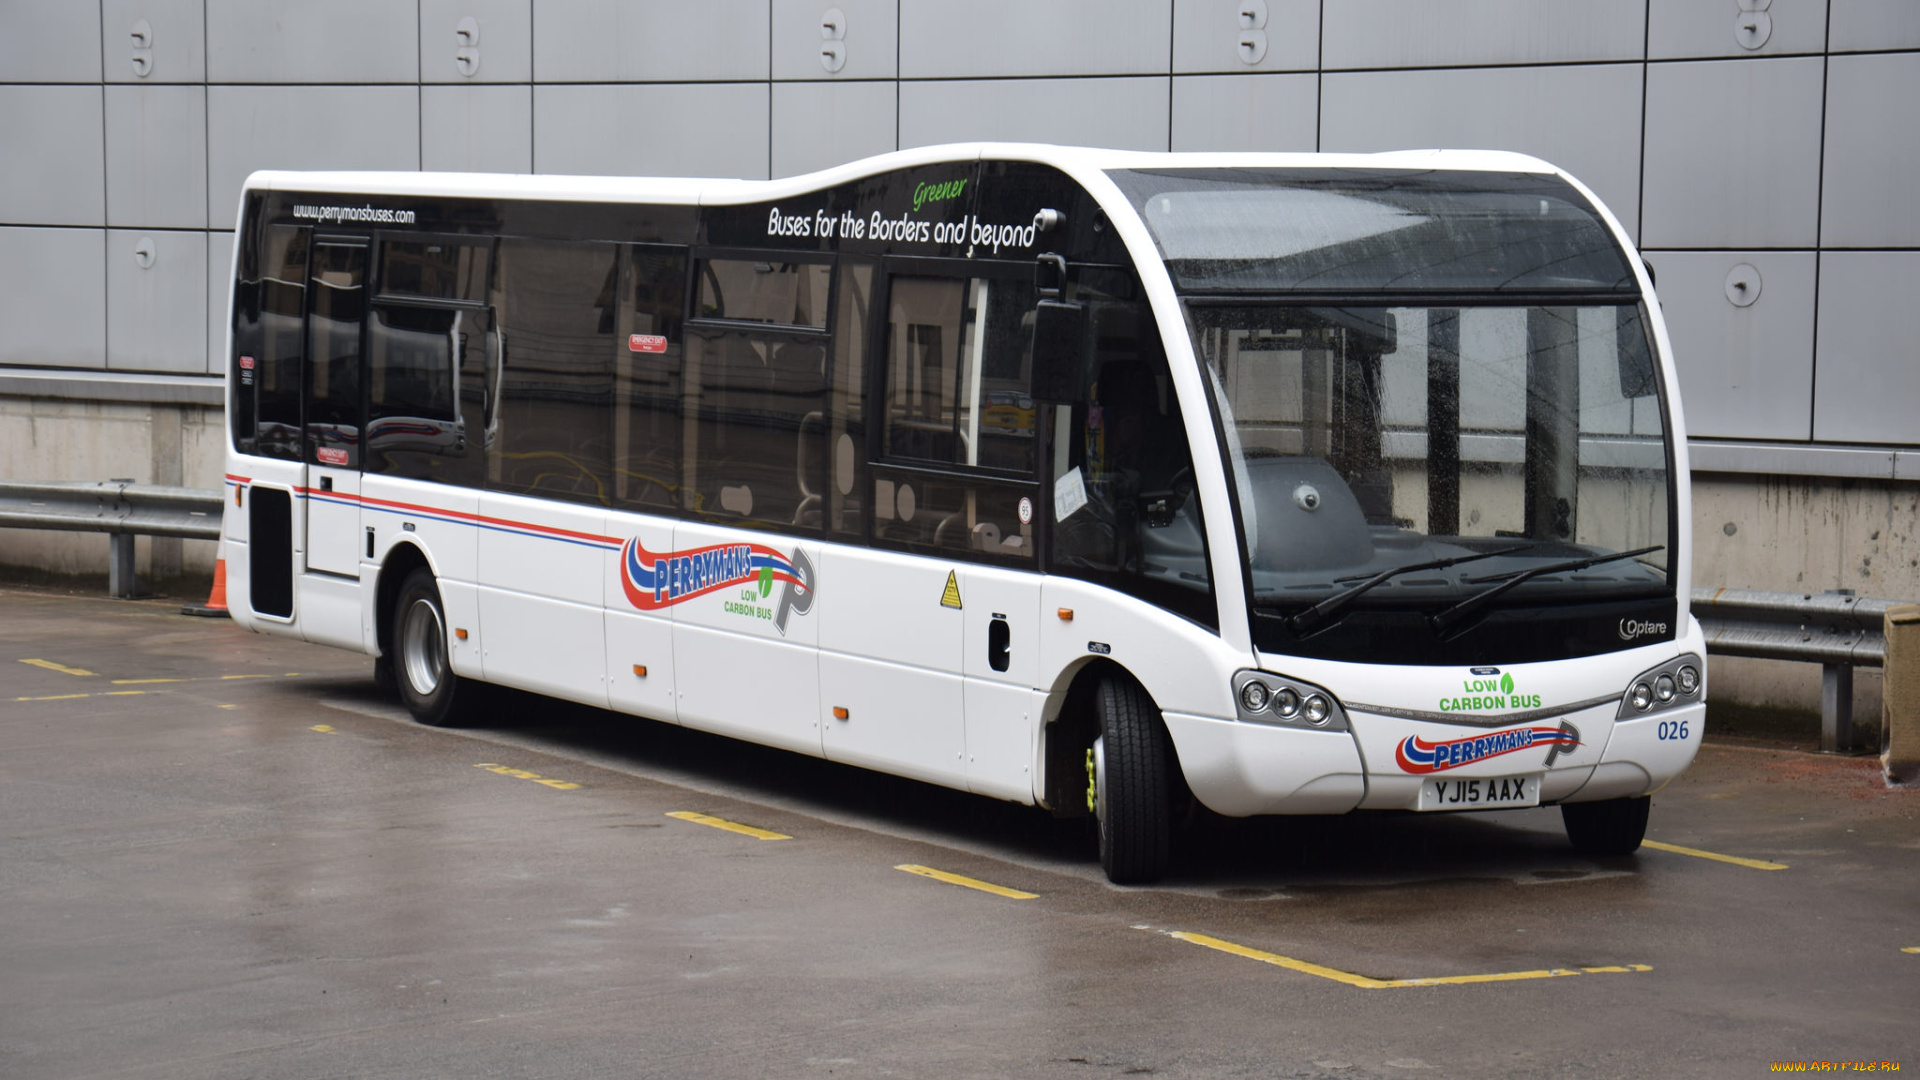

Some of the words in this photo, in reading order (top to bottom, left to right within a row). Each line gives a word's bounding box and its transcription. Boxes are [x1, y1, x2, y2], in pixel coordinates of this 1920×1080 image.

[913, 178, 968, 212] Greener
[293, 204, 415, 224] www.perrymansbuses.com
[767, 207, 811, 237] Buses
[814, 209, 838, 238] for
[840, 210, 865, 239] the
[868, 210, 930, 242] Borders
[934, 215, 968, 245] and
[971, 215, 1036, 254] beyond
[654, 545, 751, 603] PERRYMAN'S
[741, 589, 757, 602] LOW
[724, 601, 755, 617] CARBON
[756, 606, 772, 620] BUS
[1625, 619, 1667, 638] Optare
[1464, 680, 1497, 693] LOW
[1440, 696, 1505, 711] CARBON
[1511, 695, 1541, 708] BUS
[1658, 721, 1689, 740] 026
[1433, 729, 1533, 769] PERRYMAN'S
[1436, 780, 1480, 803] YJ15
[1486, 778, 1525, 801] AAX
